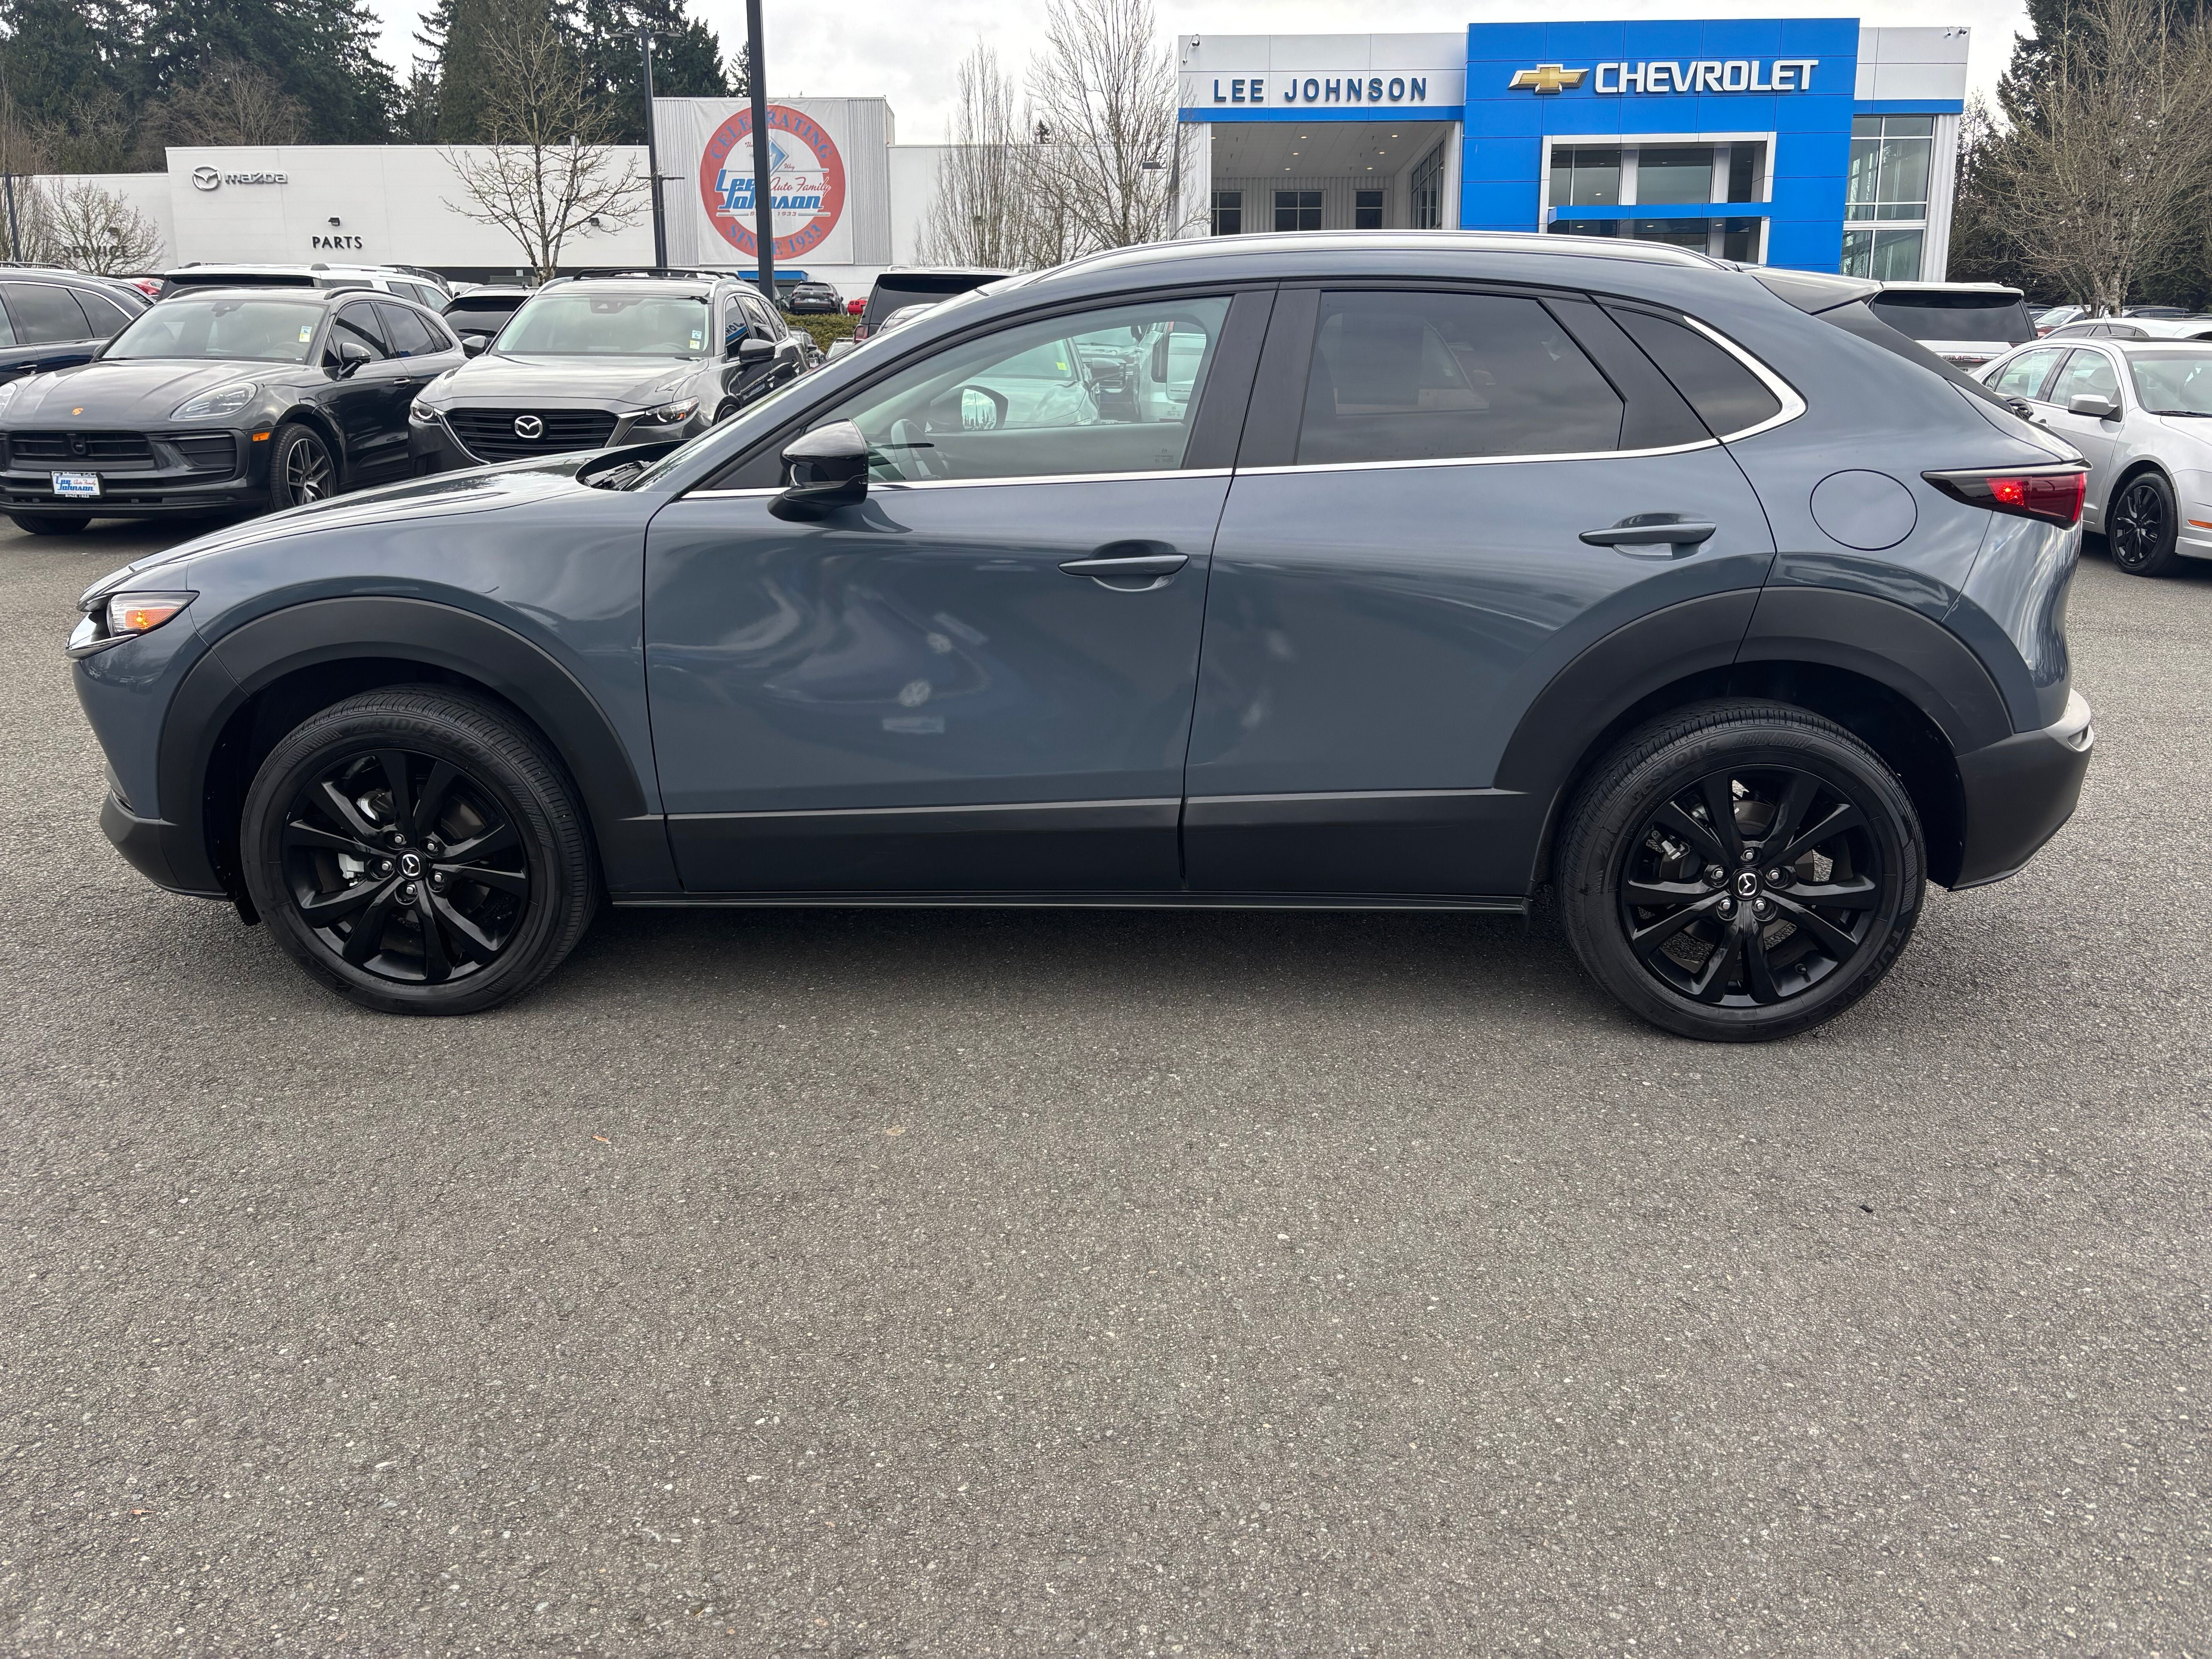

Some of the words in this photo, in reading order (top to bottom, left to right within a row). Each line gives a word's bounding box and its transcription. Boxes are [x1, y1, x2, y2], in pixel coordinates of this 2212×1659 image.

[1595, 60, 1819, 93] CHEVROLET
[1214, 79, 1264, 102] LEE
[1285, 77, 1427, 102] JOHNSON
[711, 110, 832, 159] CELERATING
[770, 177, 793, 191] Auto
[795, 176, 832, 197] Family
[312, 236, 362, 249] PARTS
[726, 225, 783, 255] SINE
[788, 224, 821, 252] 1933
[57, 483, 94, 491] Johnson
